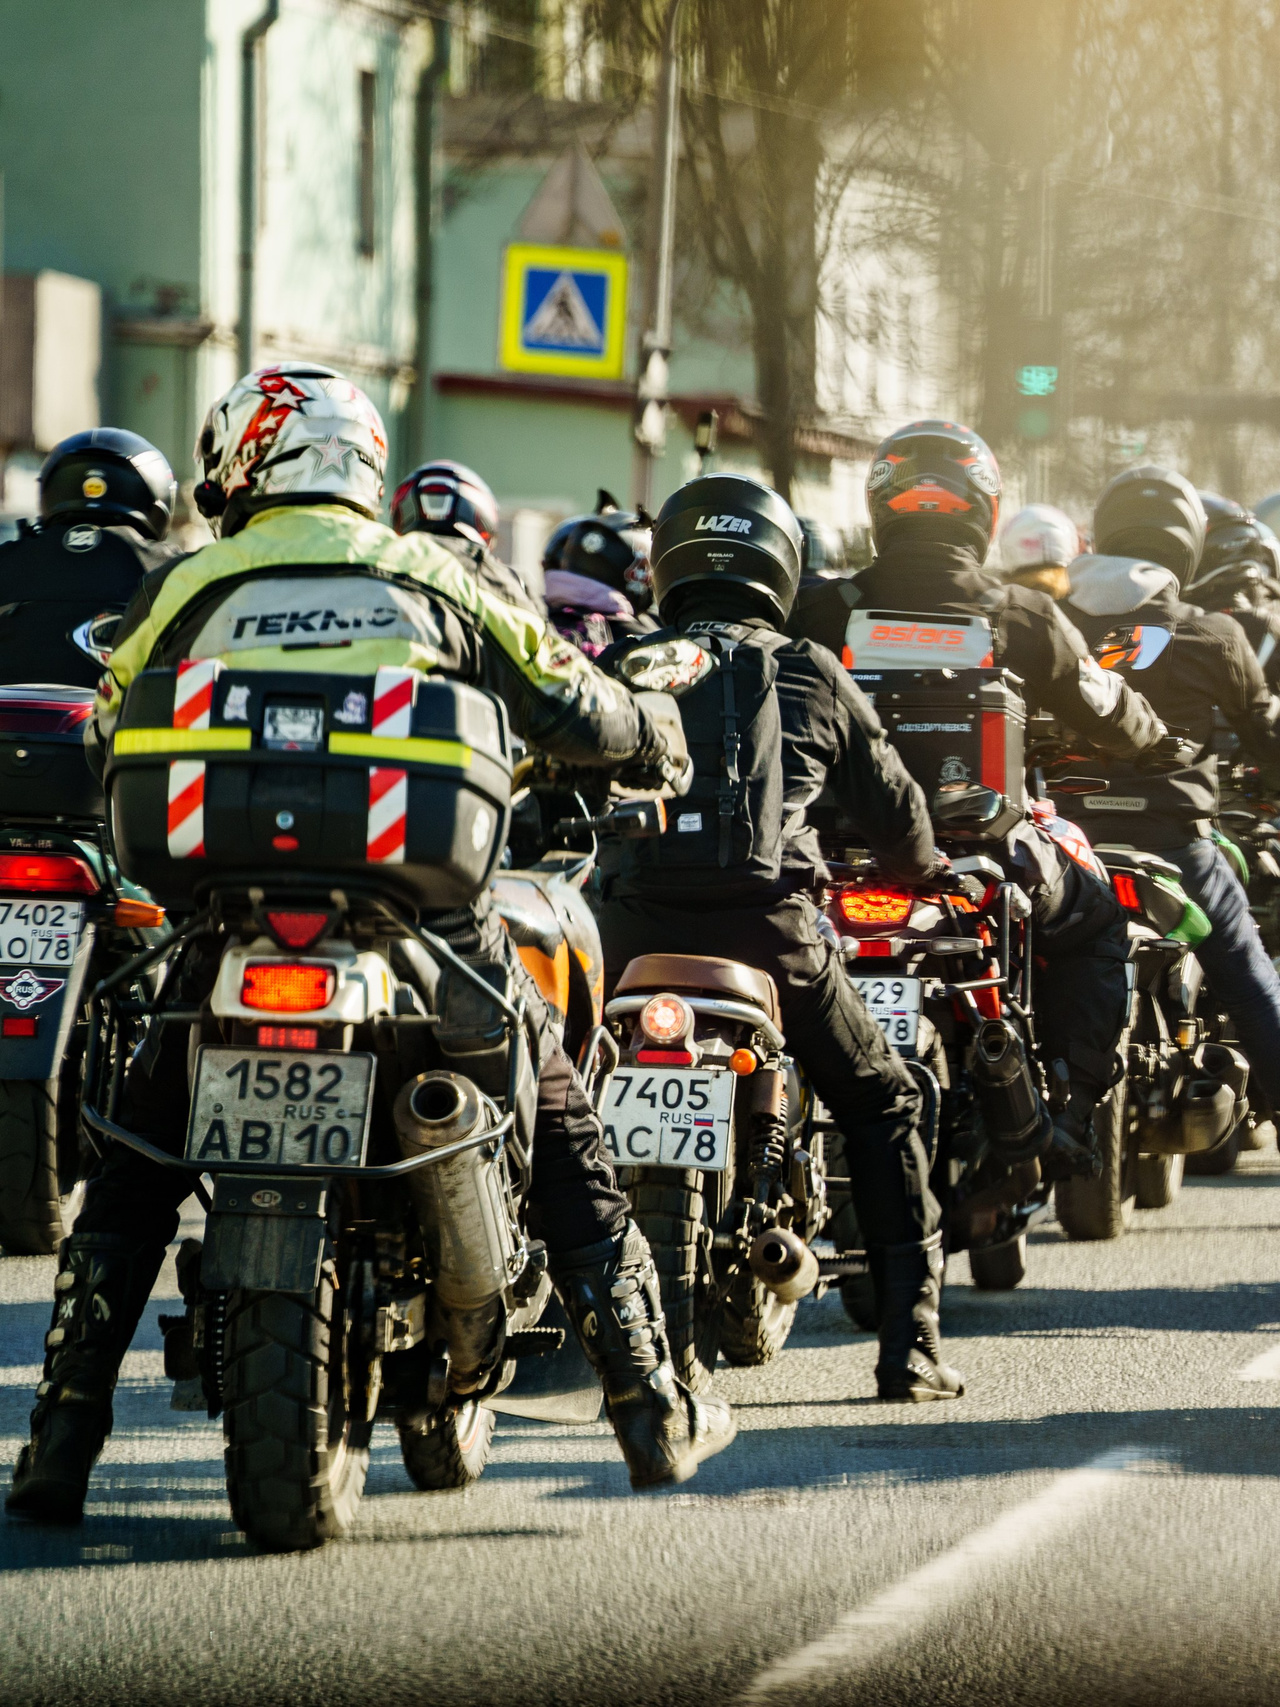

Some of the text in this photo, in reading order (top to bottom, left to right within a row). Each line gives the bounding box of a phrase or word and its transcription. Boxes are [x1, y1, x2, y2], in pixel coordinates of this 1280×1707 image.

[695, 515, 752, 534] LAZER
[870, 624, 966, 645] astars
[0, 903, 65, 927] 7402
[31, 929, 53, 938] RUS
[38, 938, 69, 961] 78
[15, 985, 34, 994] RUS
[225, 1059, 343, 1103] 1582
[613, 1076, 710, 1110] 7405
[283, 1104, 327, 1120] RUS
[660, 1112, 693, 1125] RUS
[197, 1119, 351, 1164] AB 10
[603, 1124, 716, 1162] AC 78
[619, 1301, 641, 1321] MX
